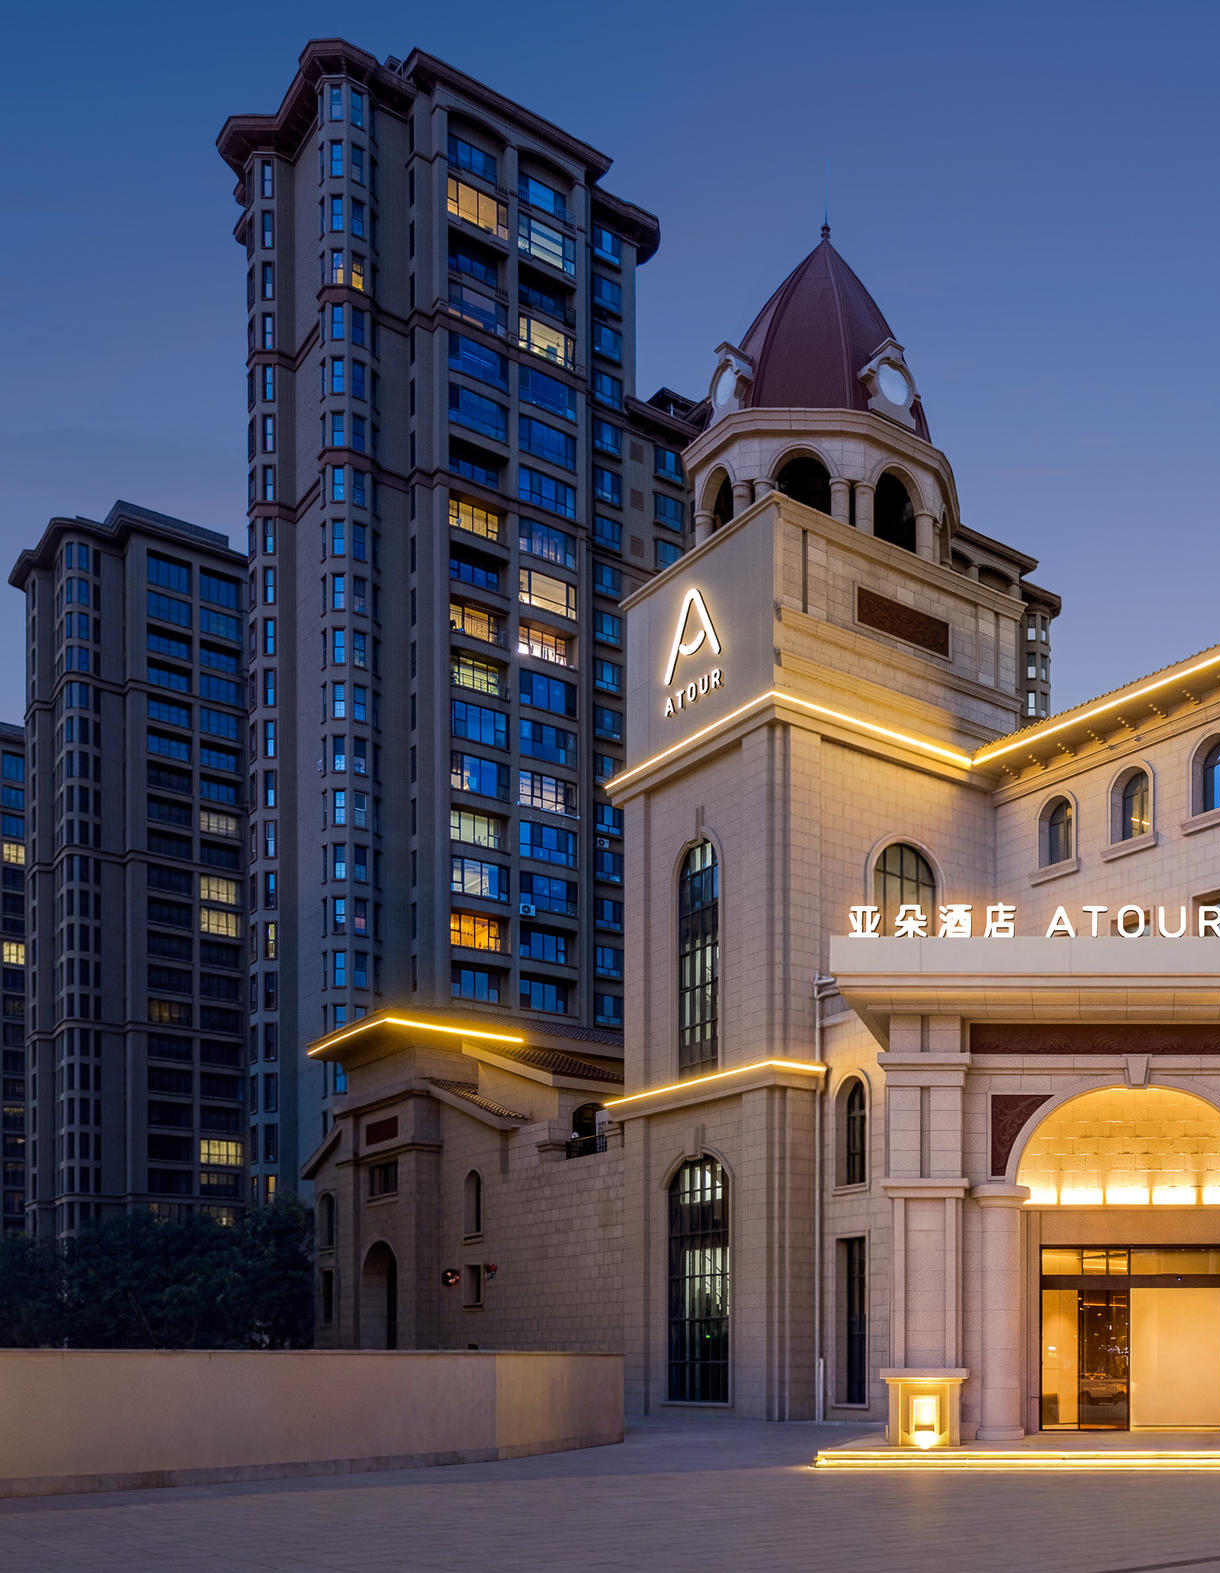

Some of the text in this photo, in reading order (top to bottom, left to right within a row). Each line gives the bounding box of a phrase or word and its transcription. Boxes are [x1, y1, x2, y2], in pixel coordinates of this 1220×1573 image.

[664, 668, 722, 717] ATOUR
[848, 902, 1016, 938] 亚朵酒店
